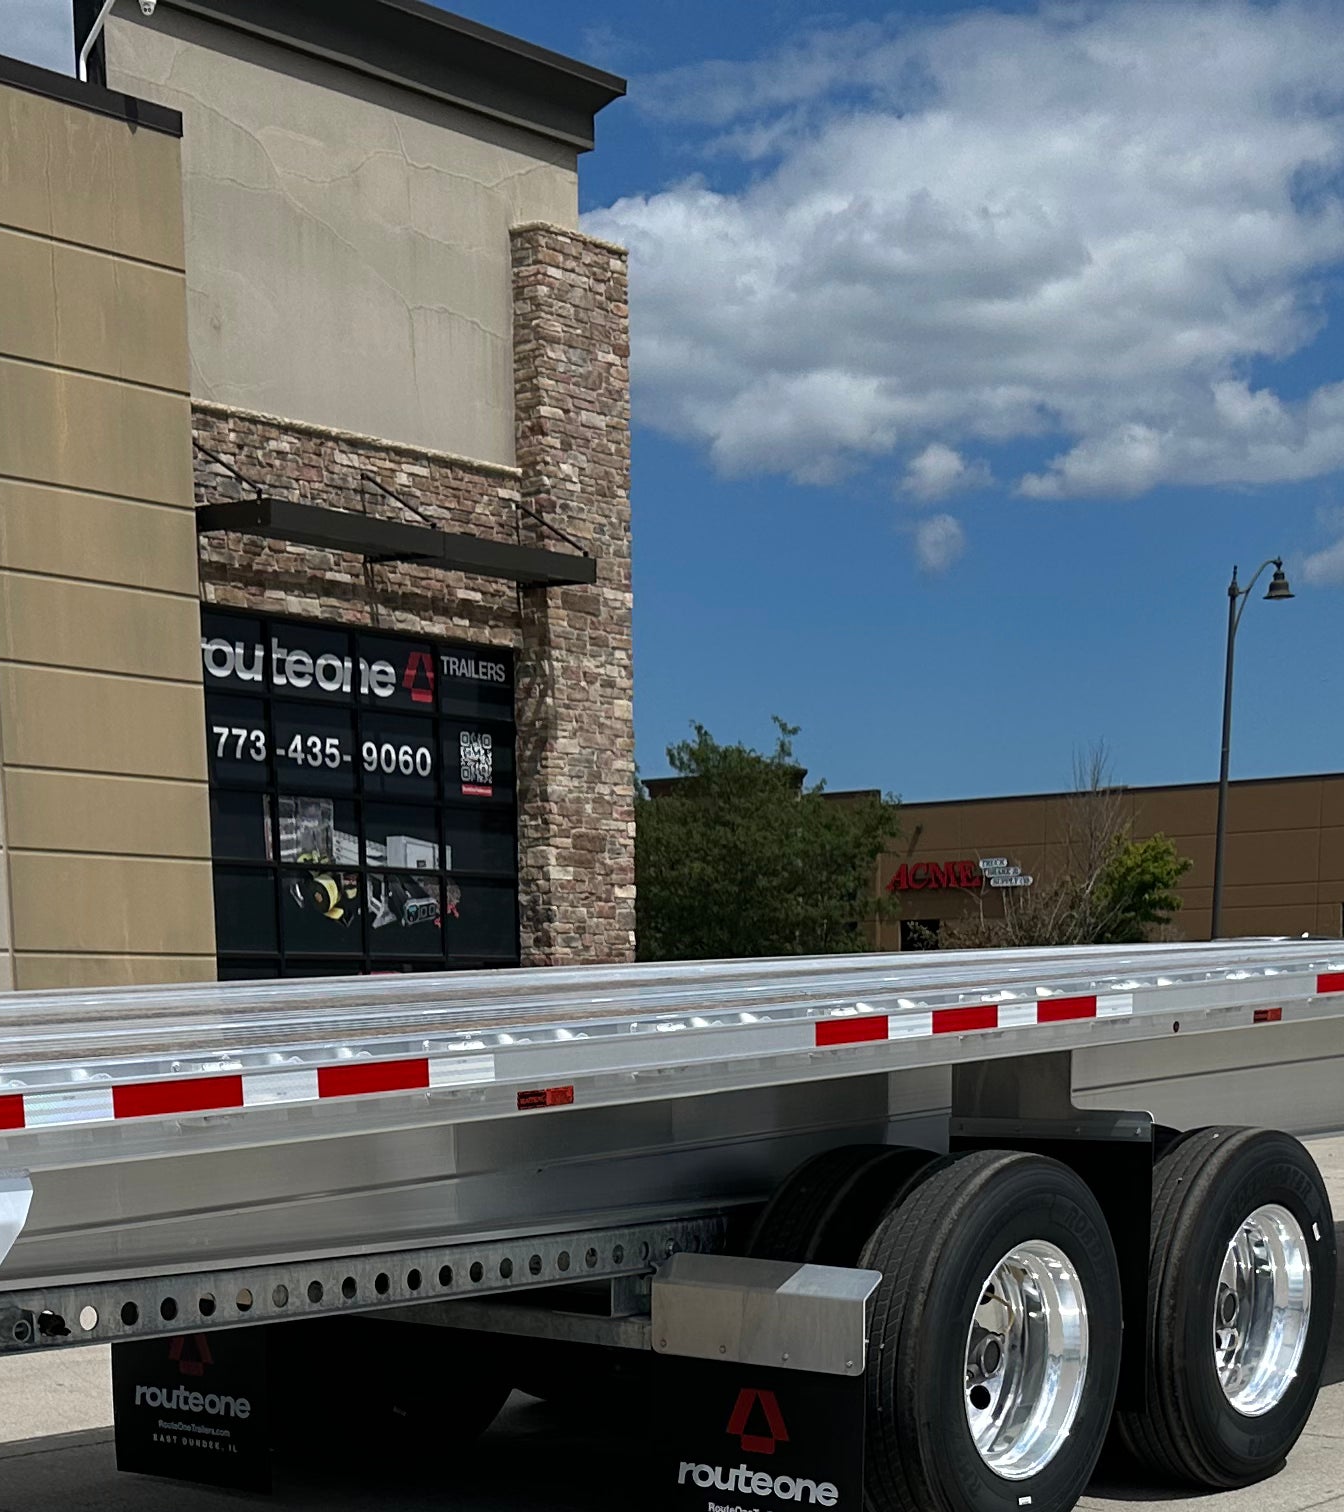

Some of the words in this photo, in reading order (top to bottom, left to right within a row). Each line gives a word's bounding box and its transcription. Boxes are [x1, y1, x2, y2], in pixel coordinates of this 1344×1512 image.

[440, 655, 506, 683] TRAILERS
[886, 860, 982, 891] ACME
[135, 1384, 251, 1418] routeone
[153, 1433, 177, 1445] EAST
[677, 1461, 839, 1507] routeone
